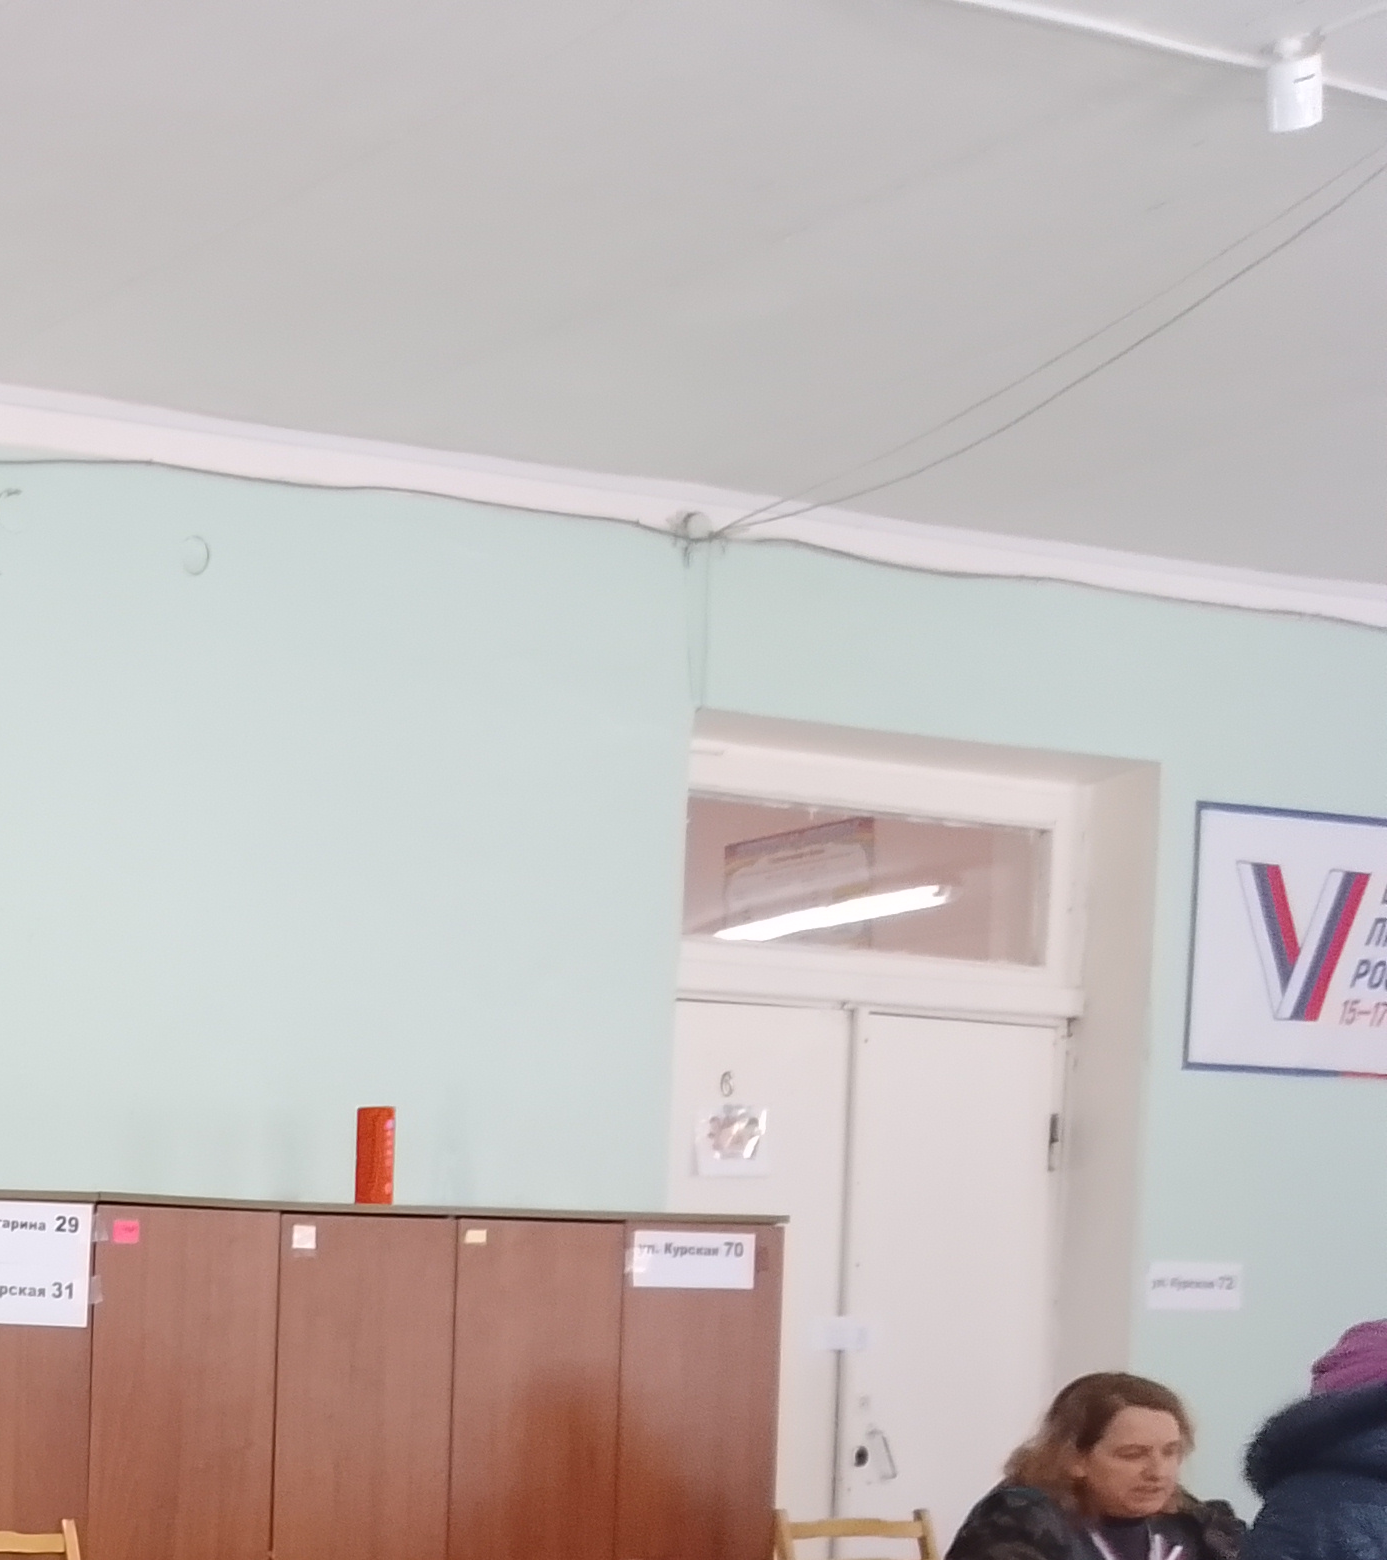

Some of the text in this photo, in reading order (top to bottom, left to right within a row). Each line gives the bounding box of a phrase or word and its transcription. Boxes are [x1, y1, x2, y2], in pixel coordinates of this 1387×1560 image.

[1350, 959, 1387, 989] РО
[54, 1215, 79, 1234] 29
[664, 1242, 719, 1258] Курская
[724, 1241, 744, 1258] 70
[51, 1282, 75, 1300] 31
